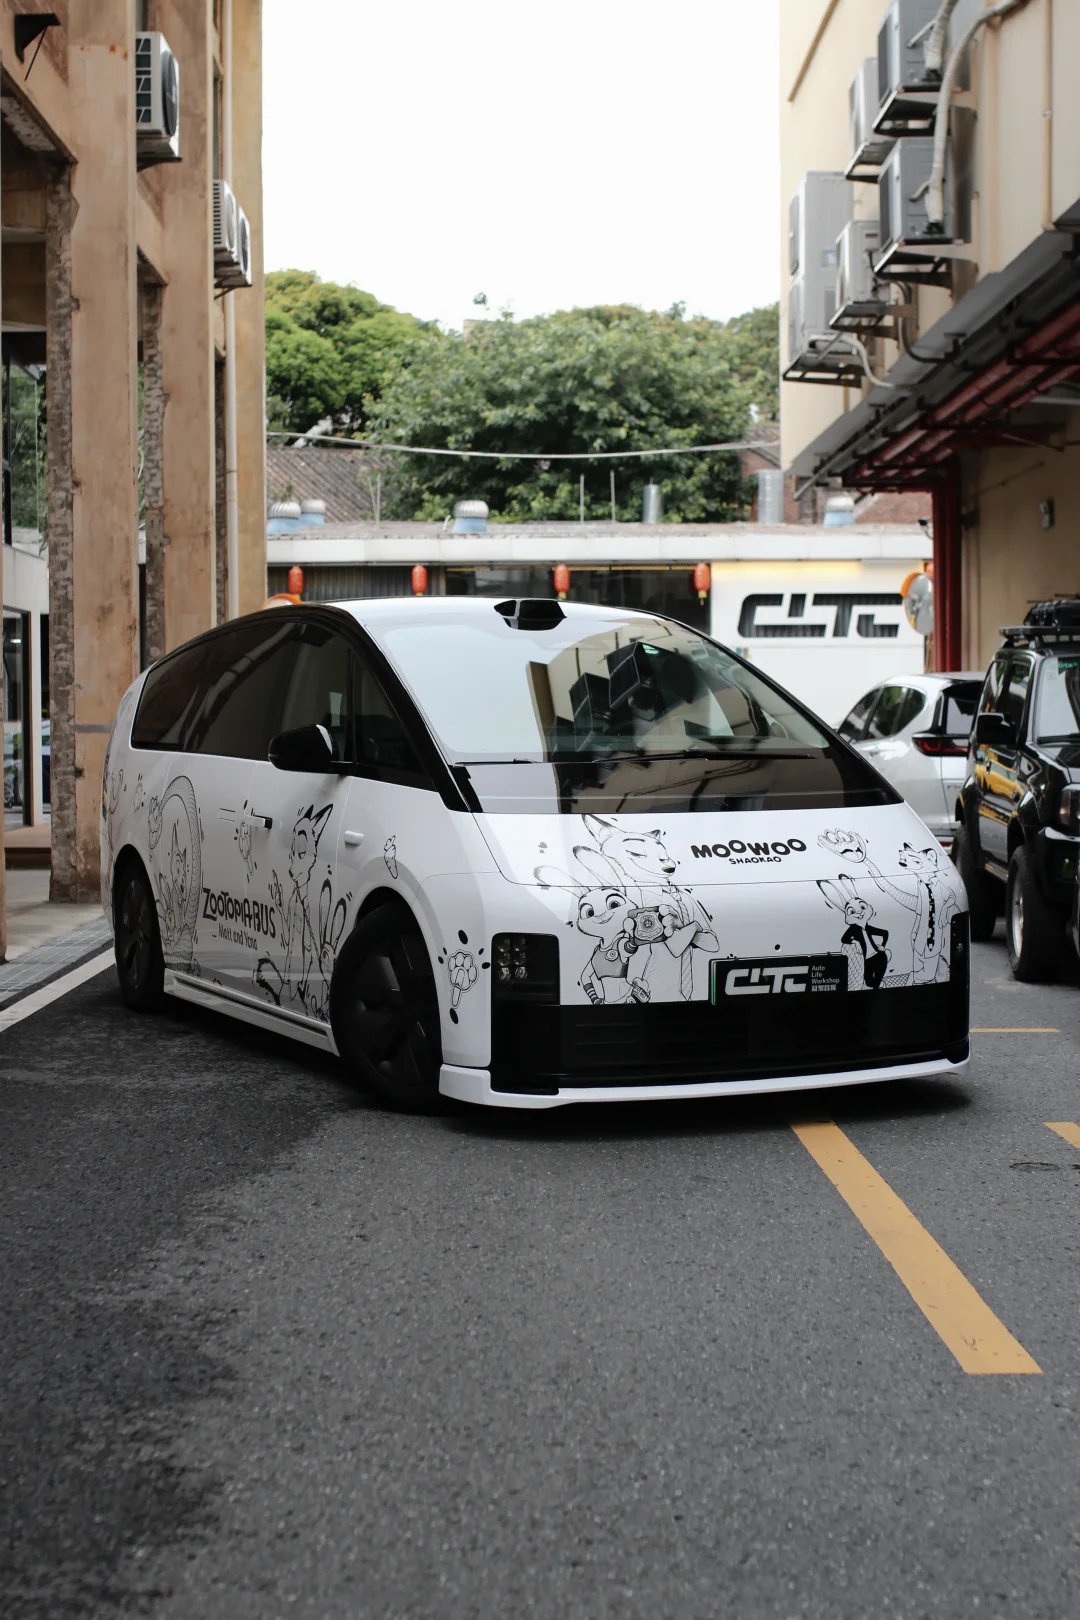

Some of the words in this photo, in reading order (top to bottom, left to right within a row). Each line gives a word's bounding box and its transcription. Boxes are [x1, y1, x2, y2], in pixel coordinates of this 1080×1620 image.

[690, 838, 807, 858] MOOWOO
[728, 856, 782, 865] SHAOKAO
[233, 929, 244, 945] and
[811, 977, 840, 985] Workshop
